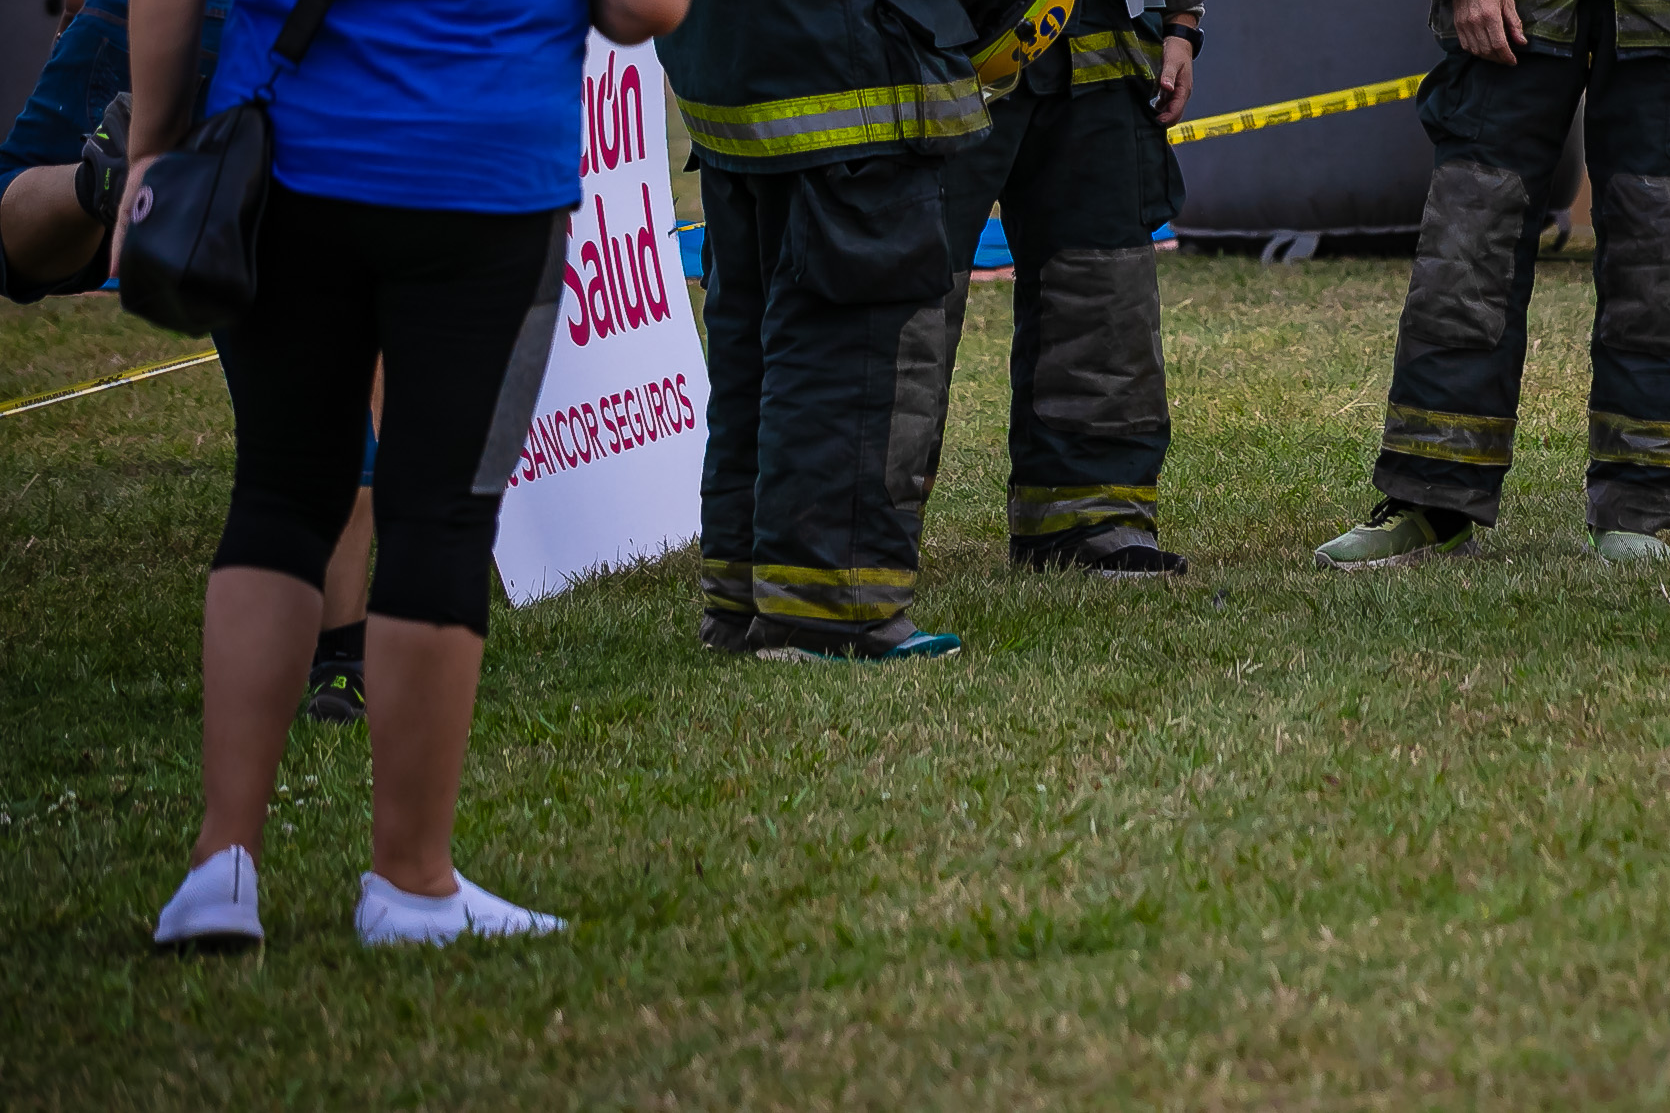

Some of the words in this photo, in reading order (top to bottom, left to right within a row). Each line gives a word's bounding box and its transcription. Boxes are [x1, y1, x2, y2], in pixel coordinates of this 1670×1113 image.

[579, 50, 646, 177] ión
[563, 182, 671, 347] Salud
[520, 402, 608, 482] SANCOR
[600, 373, 696, 454] SEGUROS
